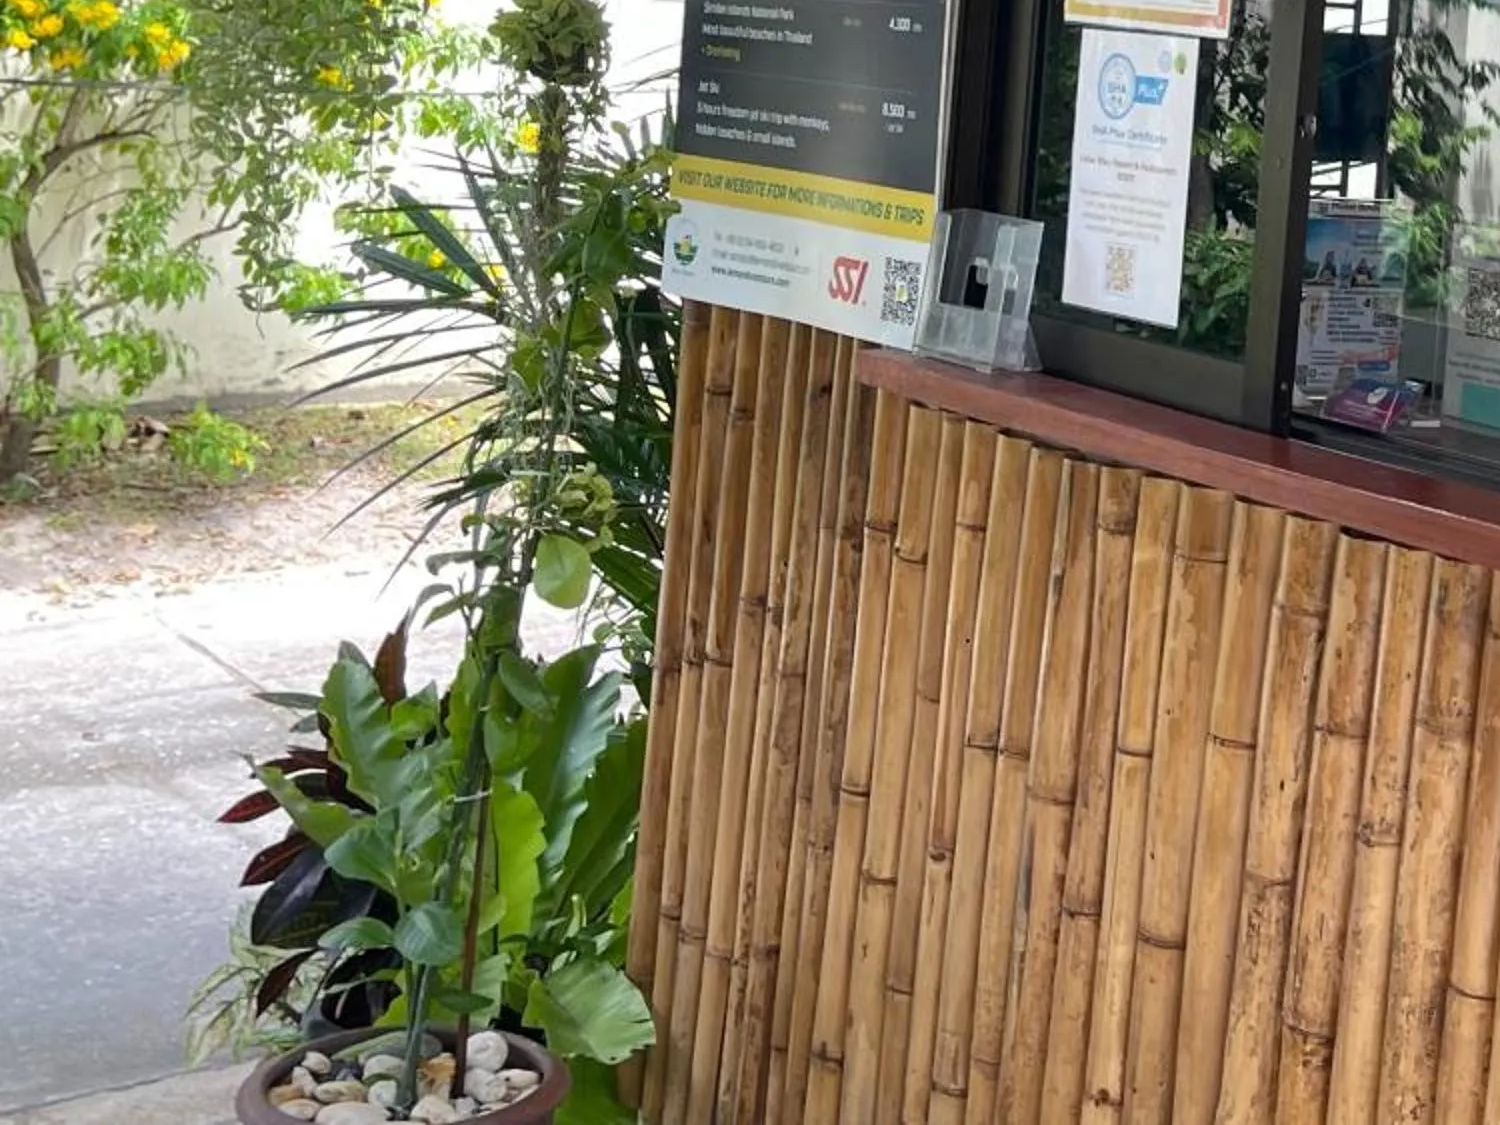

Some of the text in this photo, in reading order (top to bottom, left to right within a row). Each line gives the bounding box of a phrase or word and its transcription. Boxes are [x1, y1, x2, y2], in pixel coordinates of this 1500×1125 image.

[679, 172, 702, 186] VISIT
[703, 174, 723, 189] OUR
[724, 177, 766, 198] WEBSITE
[766, 183, 786, 200] FOR
[788, 185, 816, 204] MORE
[816, 190, 883, 218] INFORMATIONS
[894, 204, 926, 226] TRIPS
